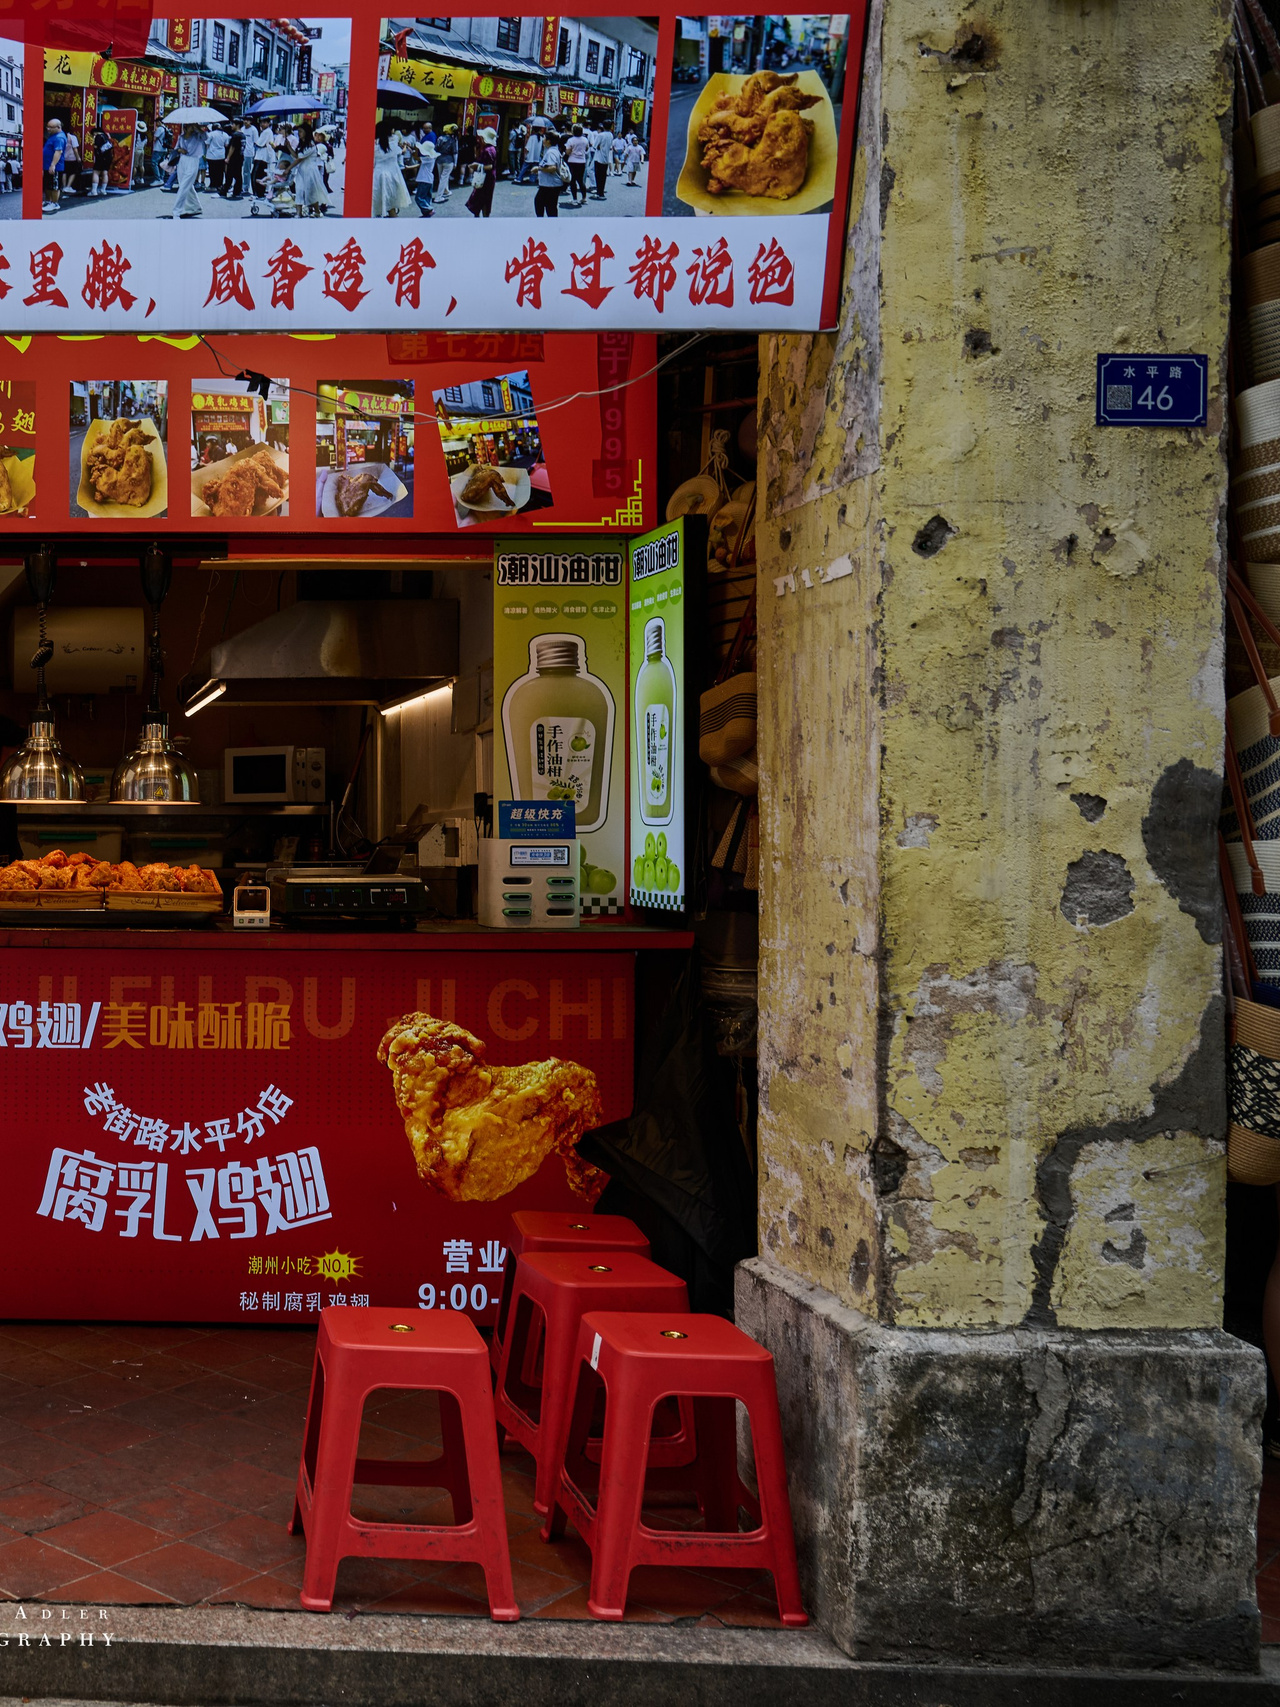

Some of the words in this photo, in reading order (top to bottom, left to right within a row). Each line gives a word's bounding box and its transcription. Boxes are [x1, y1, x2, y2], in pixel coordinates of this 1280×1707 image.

[1123, 366, 1182, 379] 水平路
[1137, 385, 1174, 411] 46
[497, 553, 623, 586] 潮汕油柑
[510, 808, 563, 820] 超级快充
[487, 977, 627, 1042] CHI
[83, 1082, 294, 1156] 老街路水平分店
[36, 1146, 333, 1243] 腐乳鸡翅
[247, 1255, 312, 1276] 潮州小吃
[322, 1258, 352, 1273] NO.1
[442, 1238, 507, 1274] 营业
